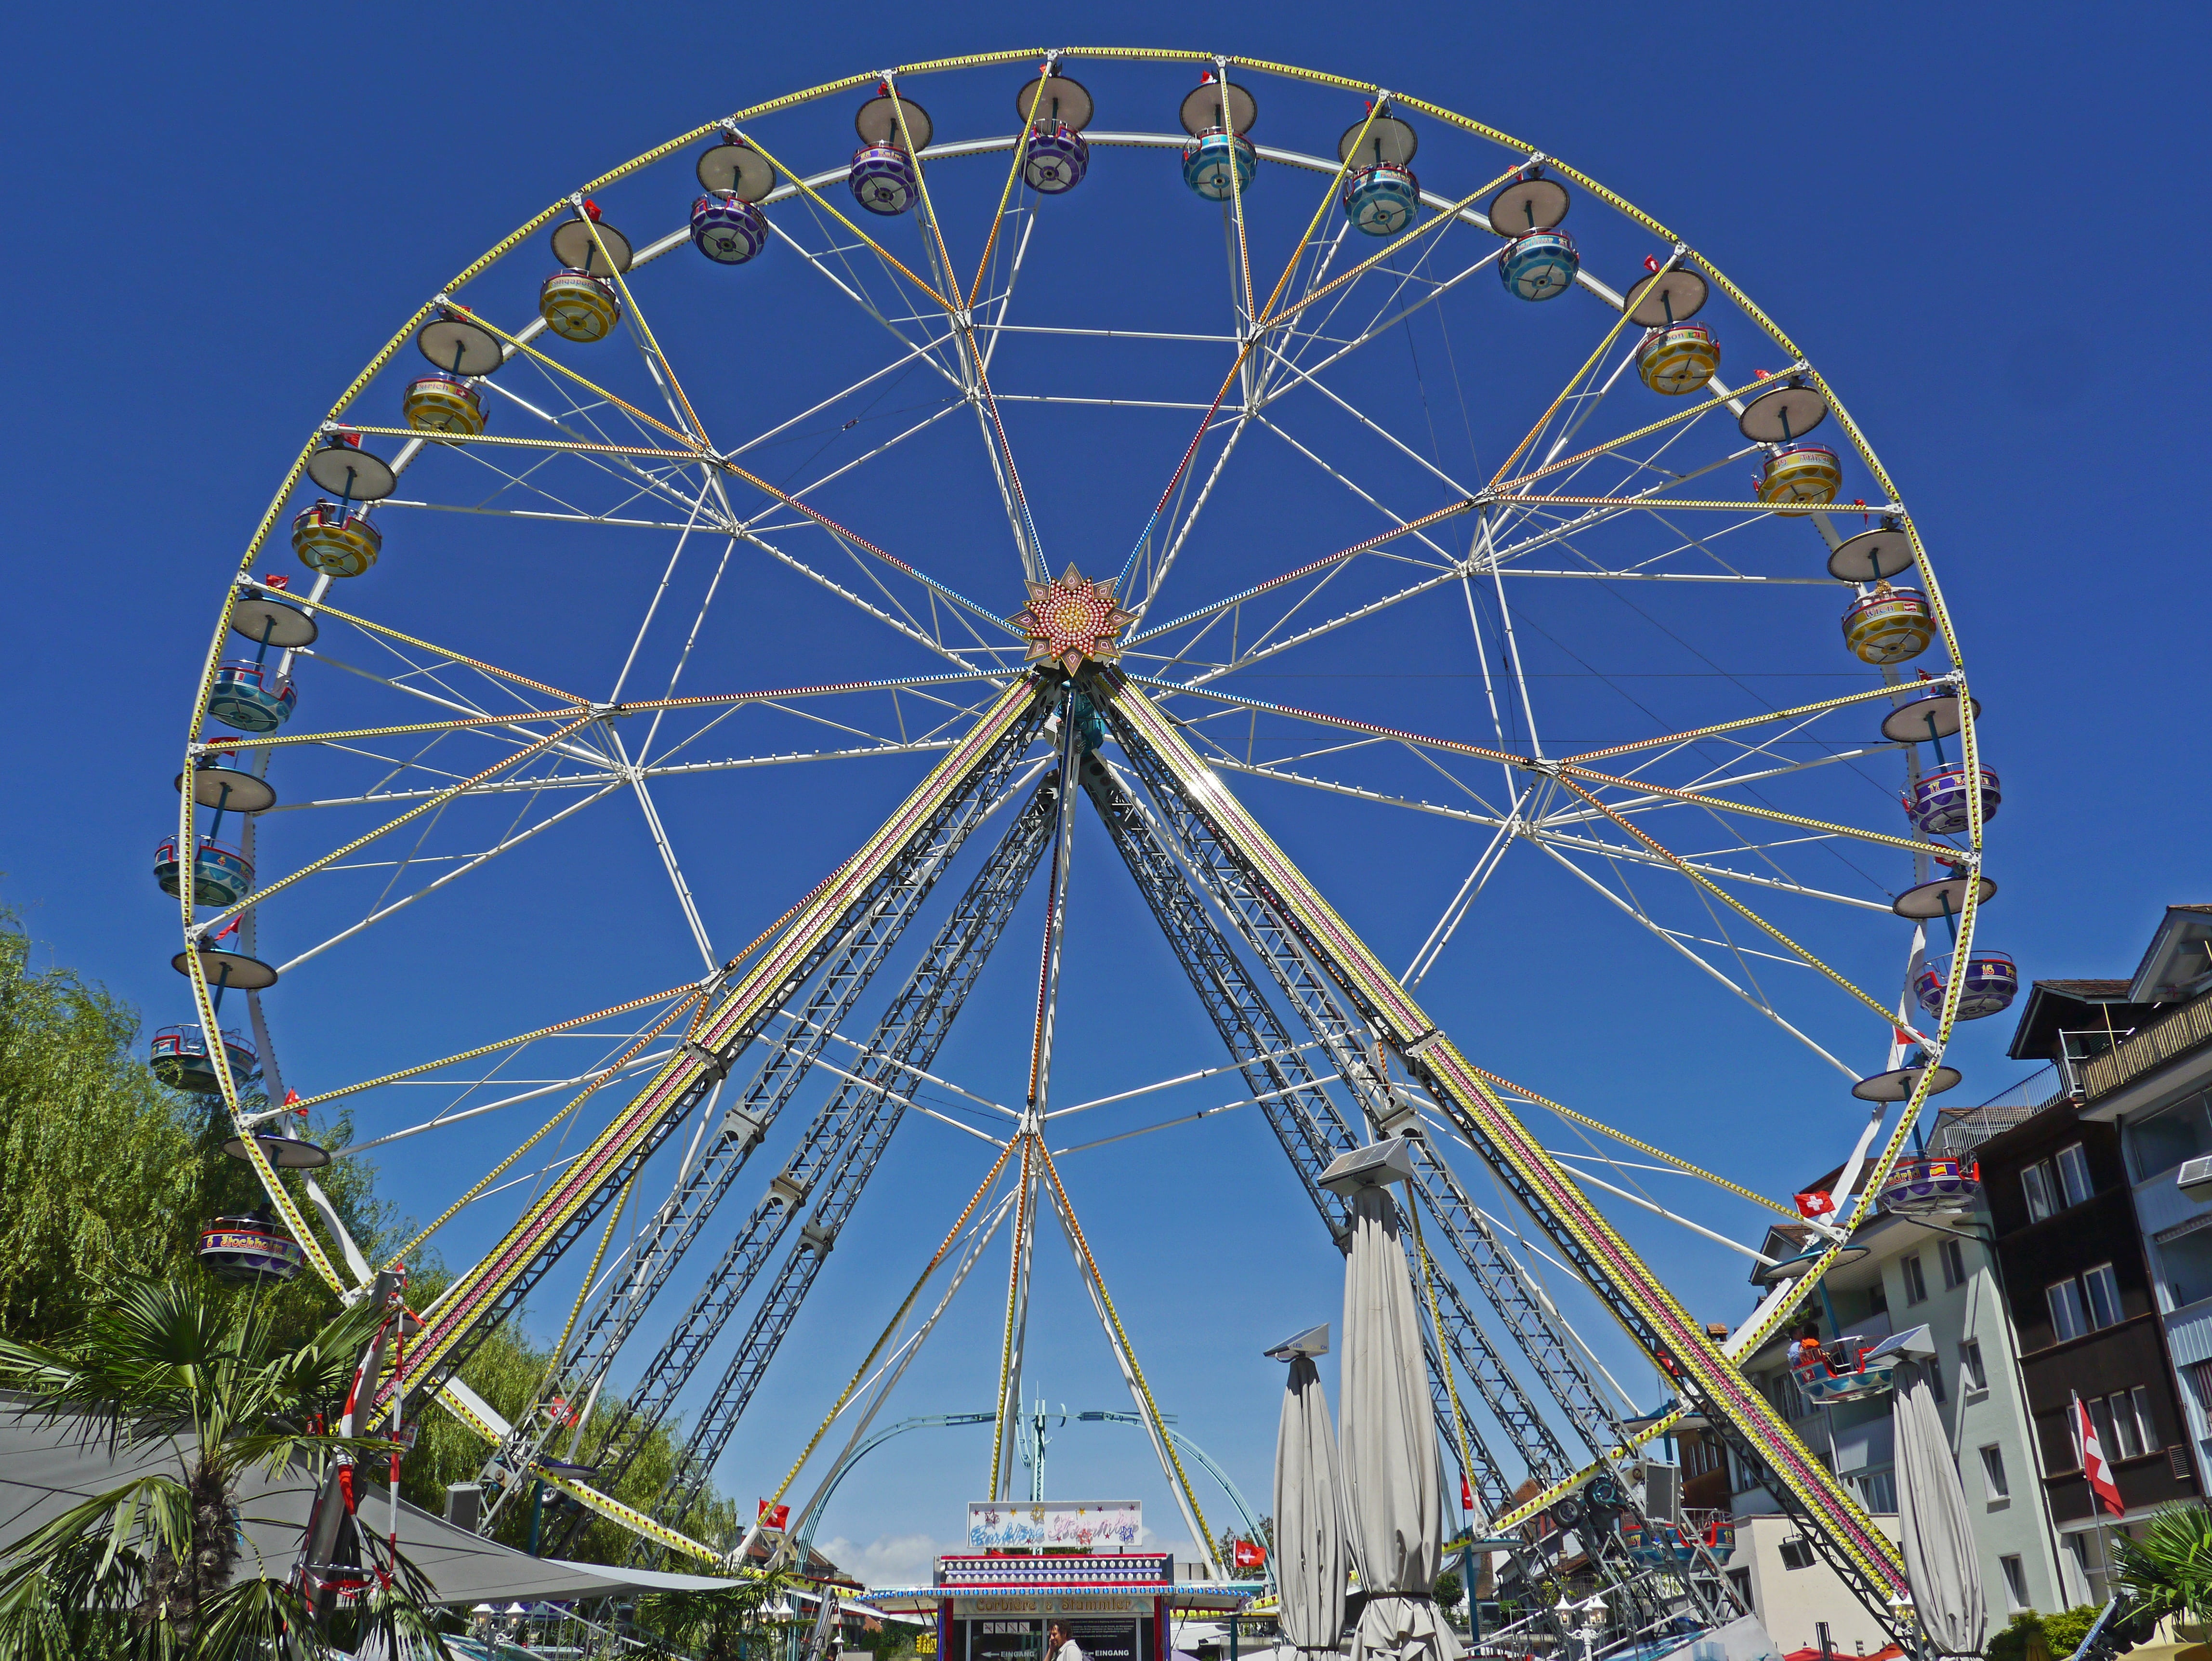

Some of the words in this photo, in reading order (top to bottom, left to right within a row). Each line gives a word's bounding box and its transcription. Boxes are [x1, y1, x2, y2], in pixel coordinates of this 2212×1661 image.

[878, 150, 905, 162] Kairo
[1380, 171, 1411, 185] Peking
[1777, 458, 1788, 468] 19
[1799, 454, 1830, 464] Athen
[1864, 605, 1894, 619] Wien
[1928, 781, 1940, 793] 17
[217, 856, 226, 866] 4
[1981, 964, 1995, 975] 16
[206, 1236, 213, 1248] 6
[220, 1235, 284, 1255] Stockholm
[976, 1598, 1036, 1611] Corbière
[1062, 1597, 1132, 1611] Stammler
